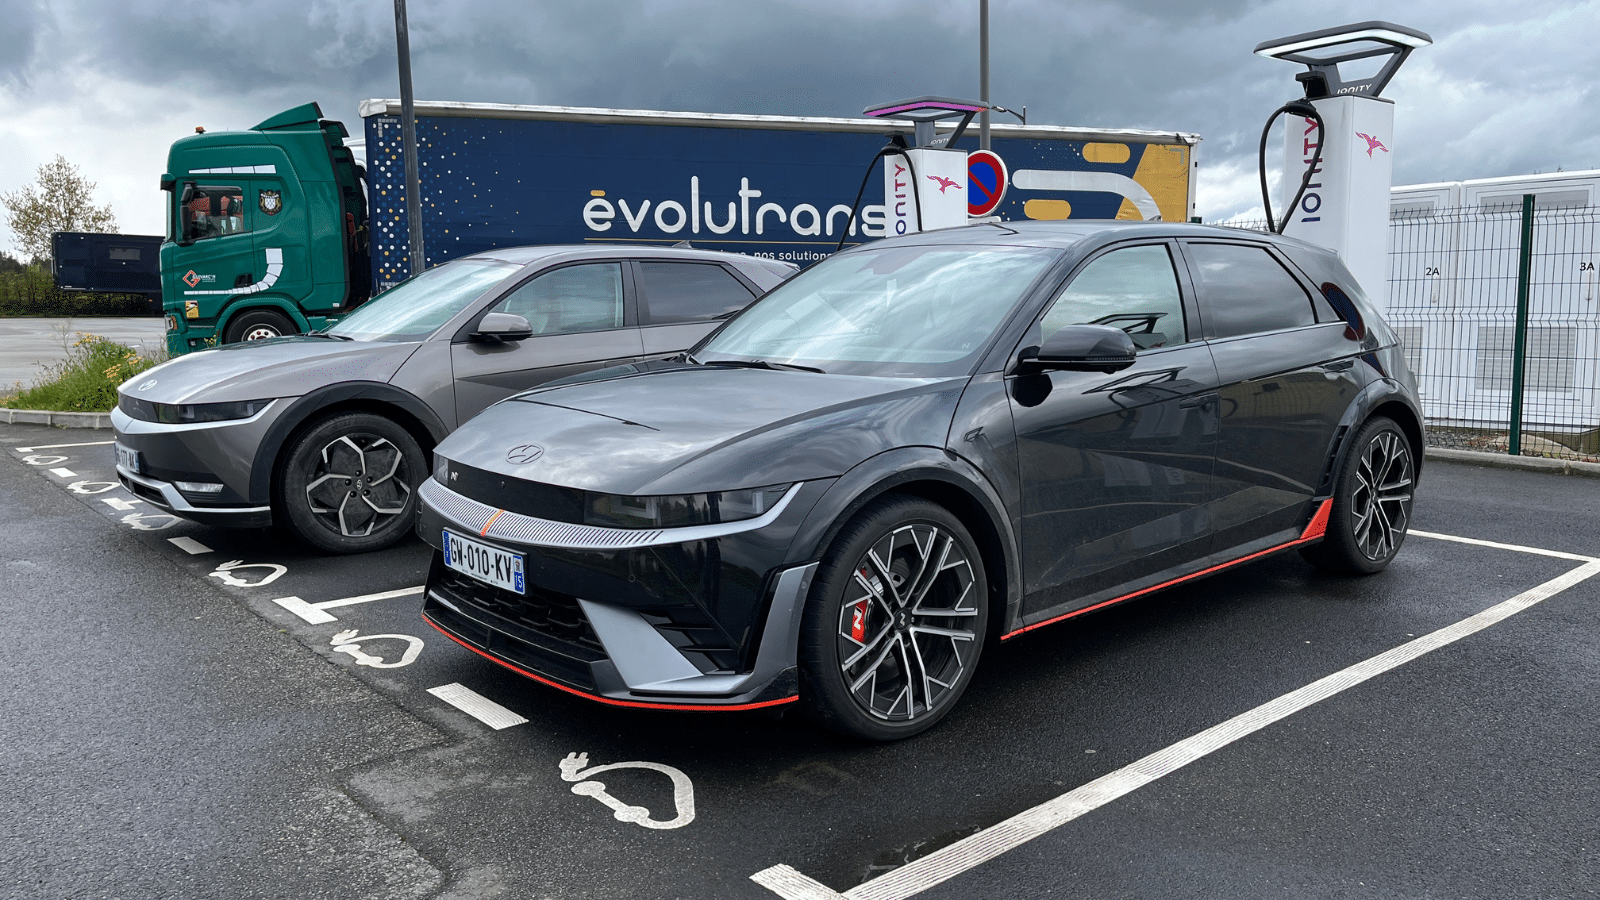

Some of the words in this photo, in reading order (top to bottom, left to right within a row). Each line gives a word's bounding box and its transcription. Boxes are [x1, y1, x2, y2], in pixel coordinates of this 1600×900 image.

[1337, 83, 1372, 95] IONITY
[895, 163, 906, 235] ONITY
[754, 251, 775, 260] nos
[1425, 267, 1440, 276] 2A
[1579, 262, 1595, 271] 3A
[450, 537, 512, 583] GW-010-KV
